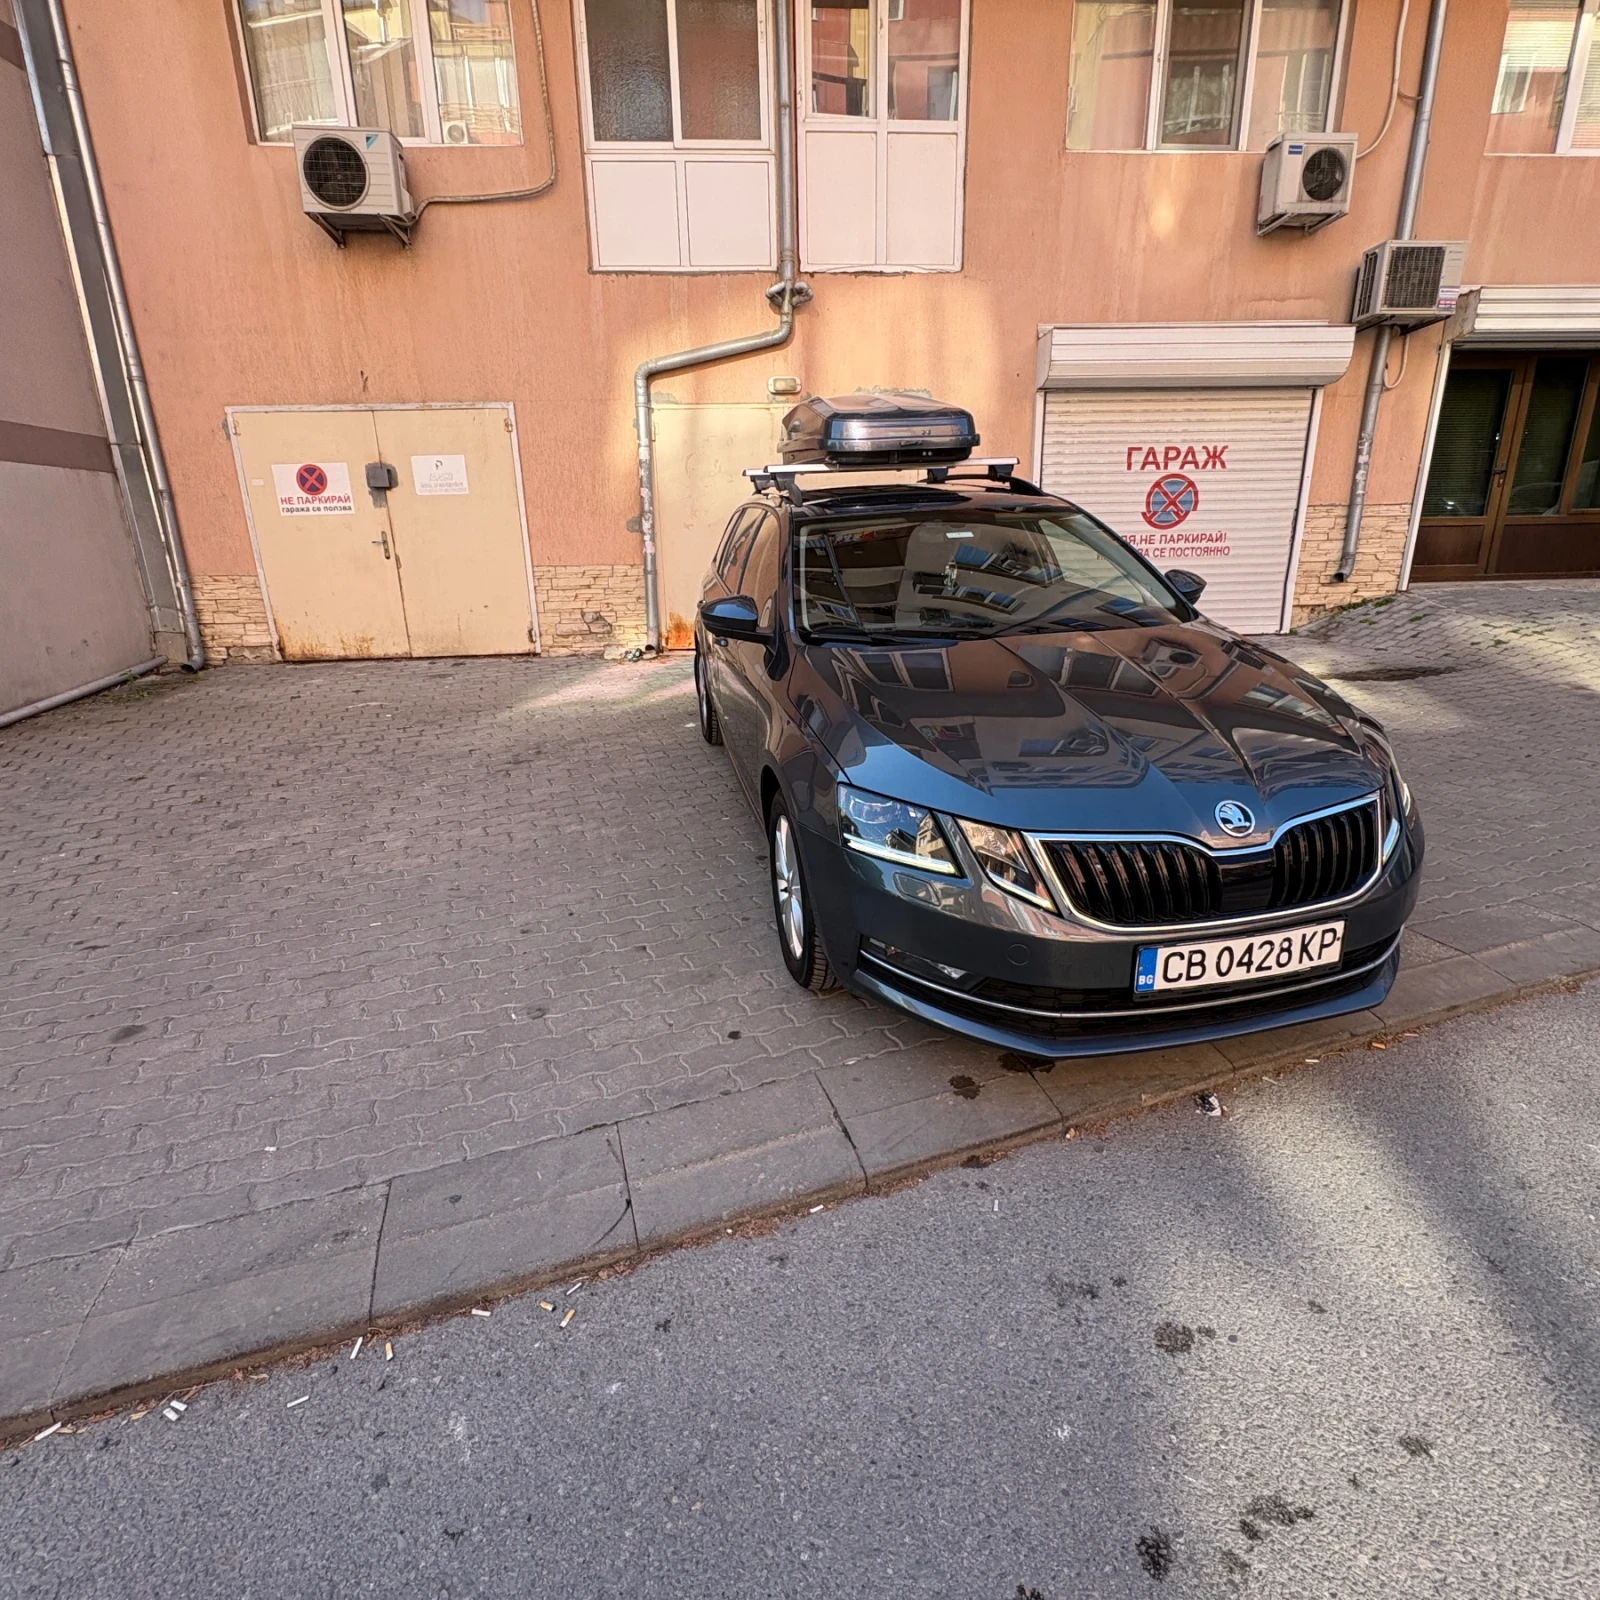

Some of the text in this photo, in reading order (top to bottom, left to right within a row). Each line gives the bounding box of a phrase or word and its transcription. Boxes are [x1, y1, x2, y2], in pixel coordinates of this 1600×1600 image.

[1126, 445, 1229, 471] ГАРАЖ
[280, 493, 351, 505] НЕ ПАРКИРАЙ
[282, 506, 310, 514] гаража
[1159, 531, 1227, 545] ПАРКИРАЙ!
[1152, 547, 1166, 558] СЕ
[1168, 546, 1231, 558] ПОСТОЯННО
[1162, 927, 1338, 984] CB 0428 KP
[1138, 974, 1154, 986] BG
